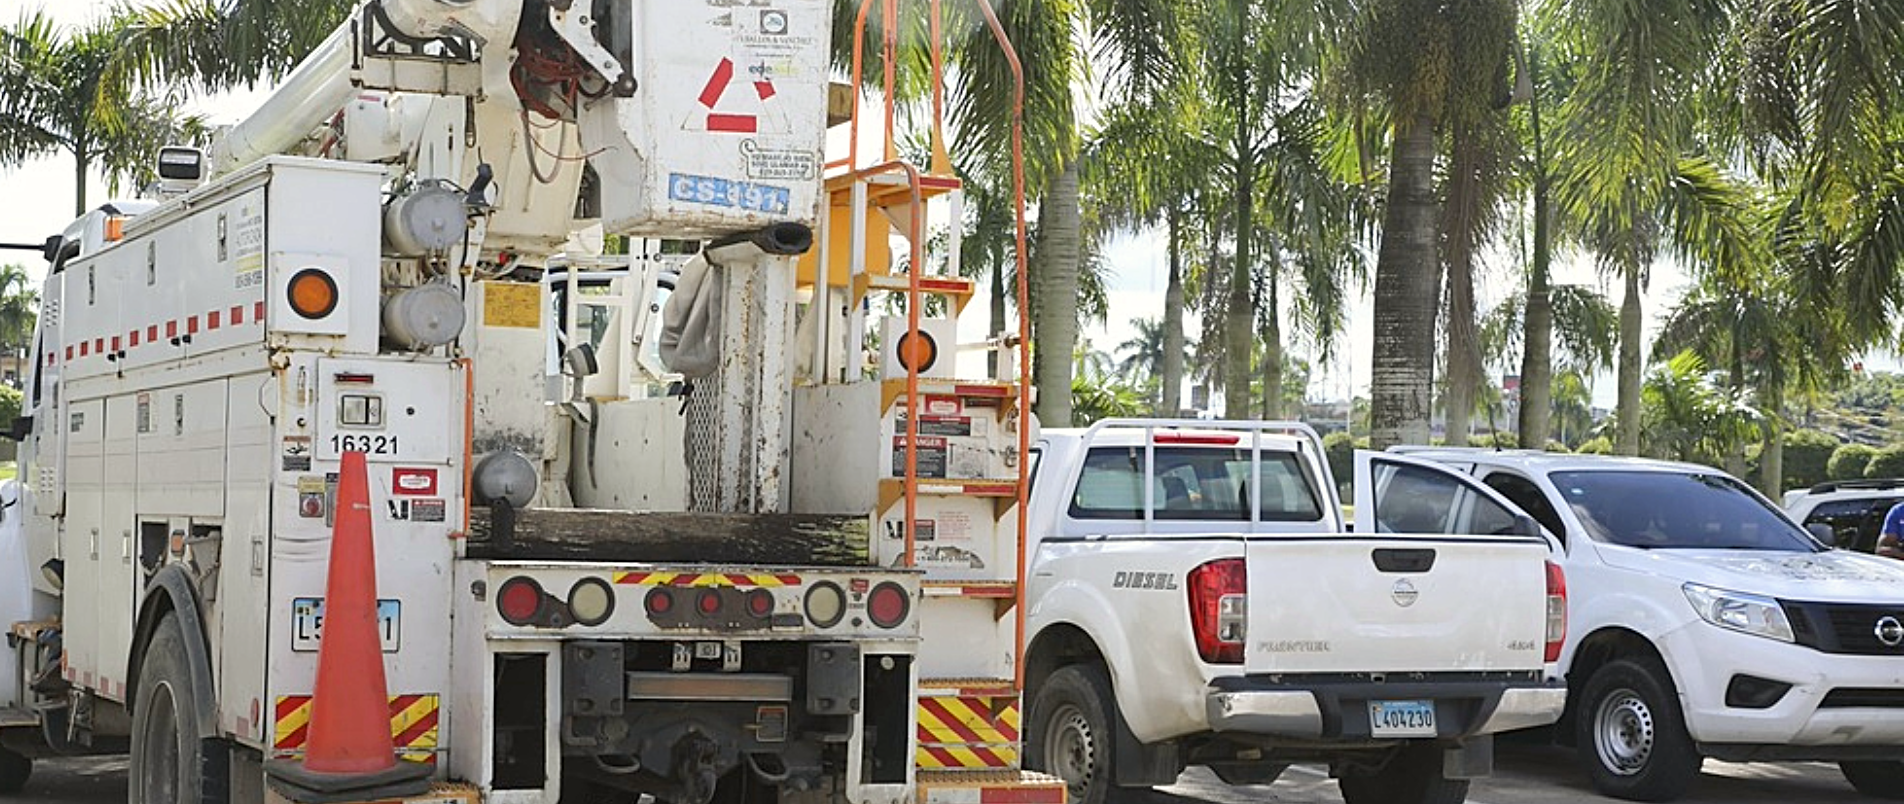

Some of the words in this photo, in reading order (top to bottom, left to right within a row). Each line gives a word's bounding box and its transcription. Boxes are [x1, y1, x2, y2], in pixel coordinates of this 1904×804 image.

[331, 433, 398, 455] 16321
[1112, 571, 1177, 590] DIESEL
[1372, 709, 1432, 729] L404230
